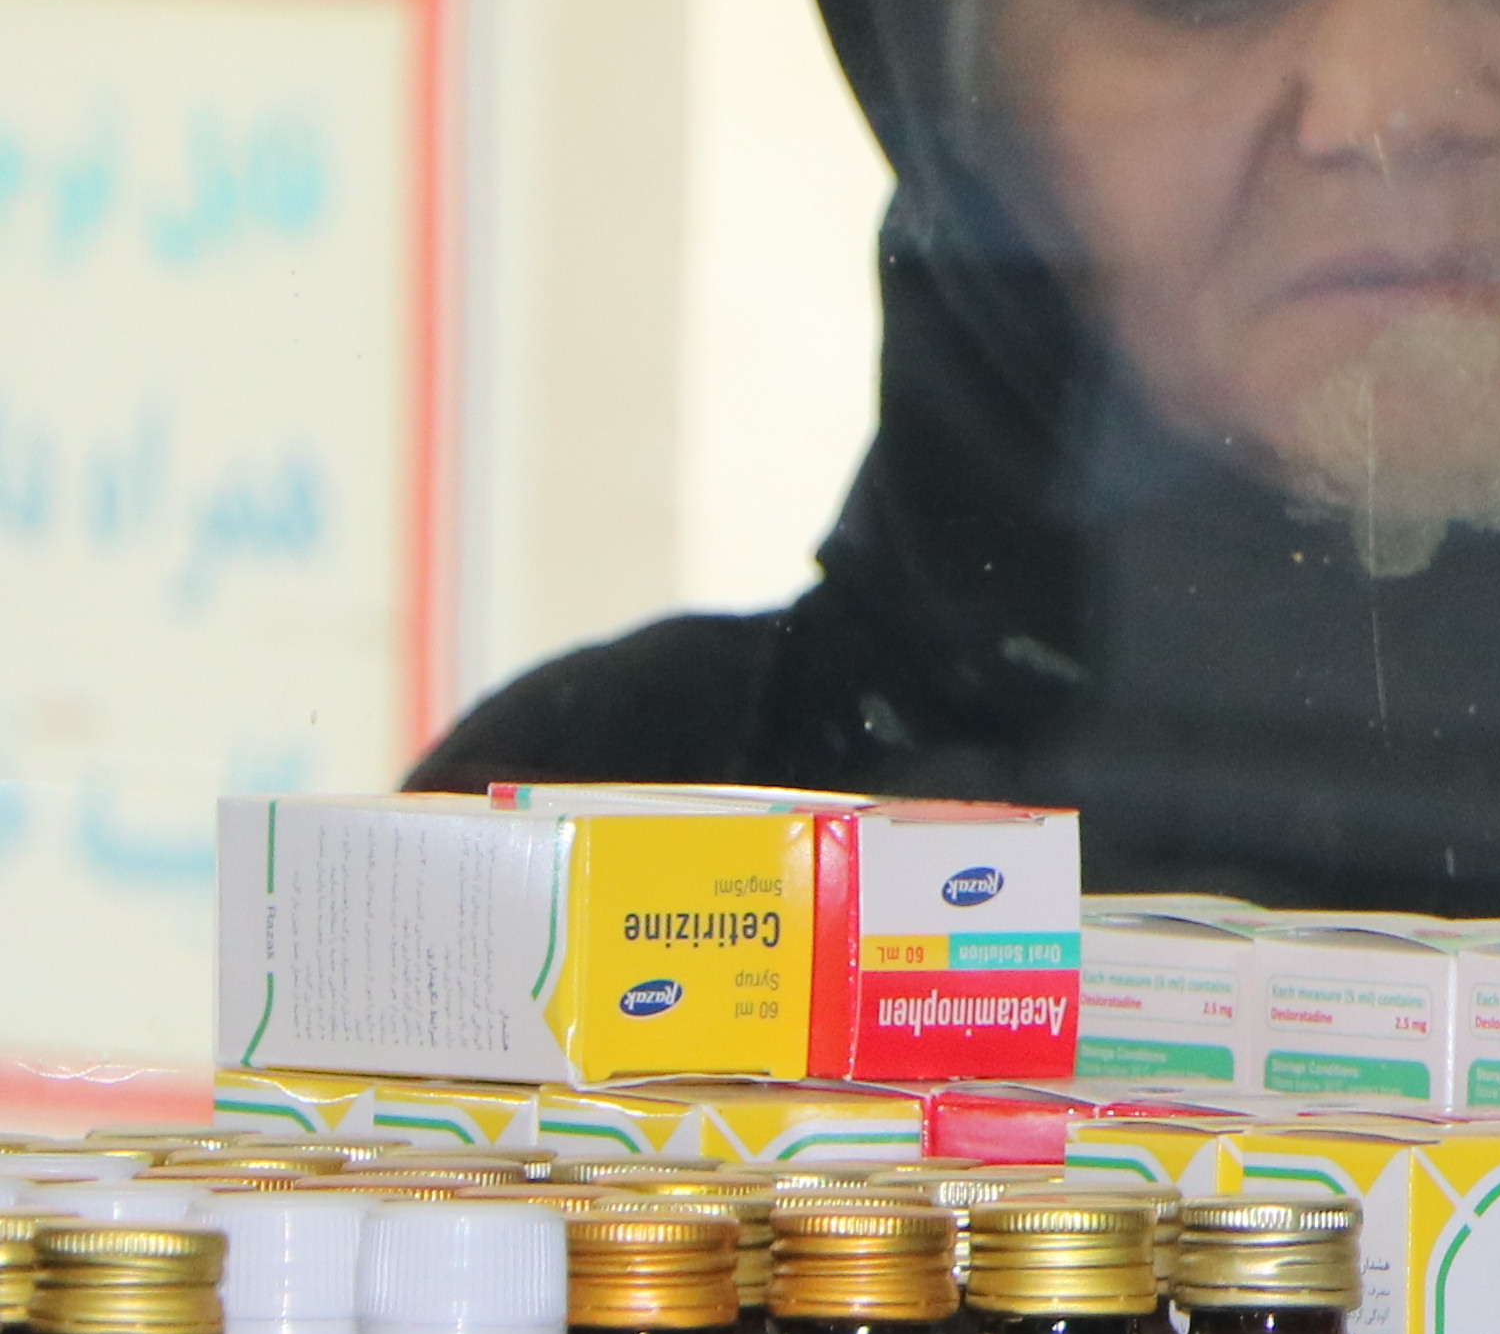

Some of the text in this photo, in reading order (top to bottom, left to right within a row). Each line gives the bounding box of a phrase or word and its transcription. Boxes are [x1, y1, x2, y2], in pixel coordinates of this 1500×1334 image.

[714, 877, 783, 898] 5mg/5ml
[945, 867, 1003, 903] Razak
[624, 912, 782, 949] Cetirizine
[876, 943, 1062, 963] Oral Solution 60 mL
[735, 972, 780, 990] Syrup
[624, 980, 682, 1012] Razak
[735, 1001, 778, 1019] 60 ml
[878, 989, 1067, 1037] Acetaminophen
